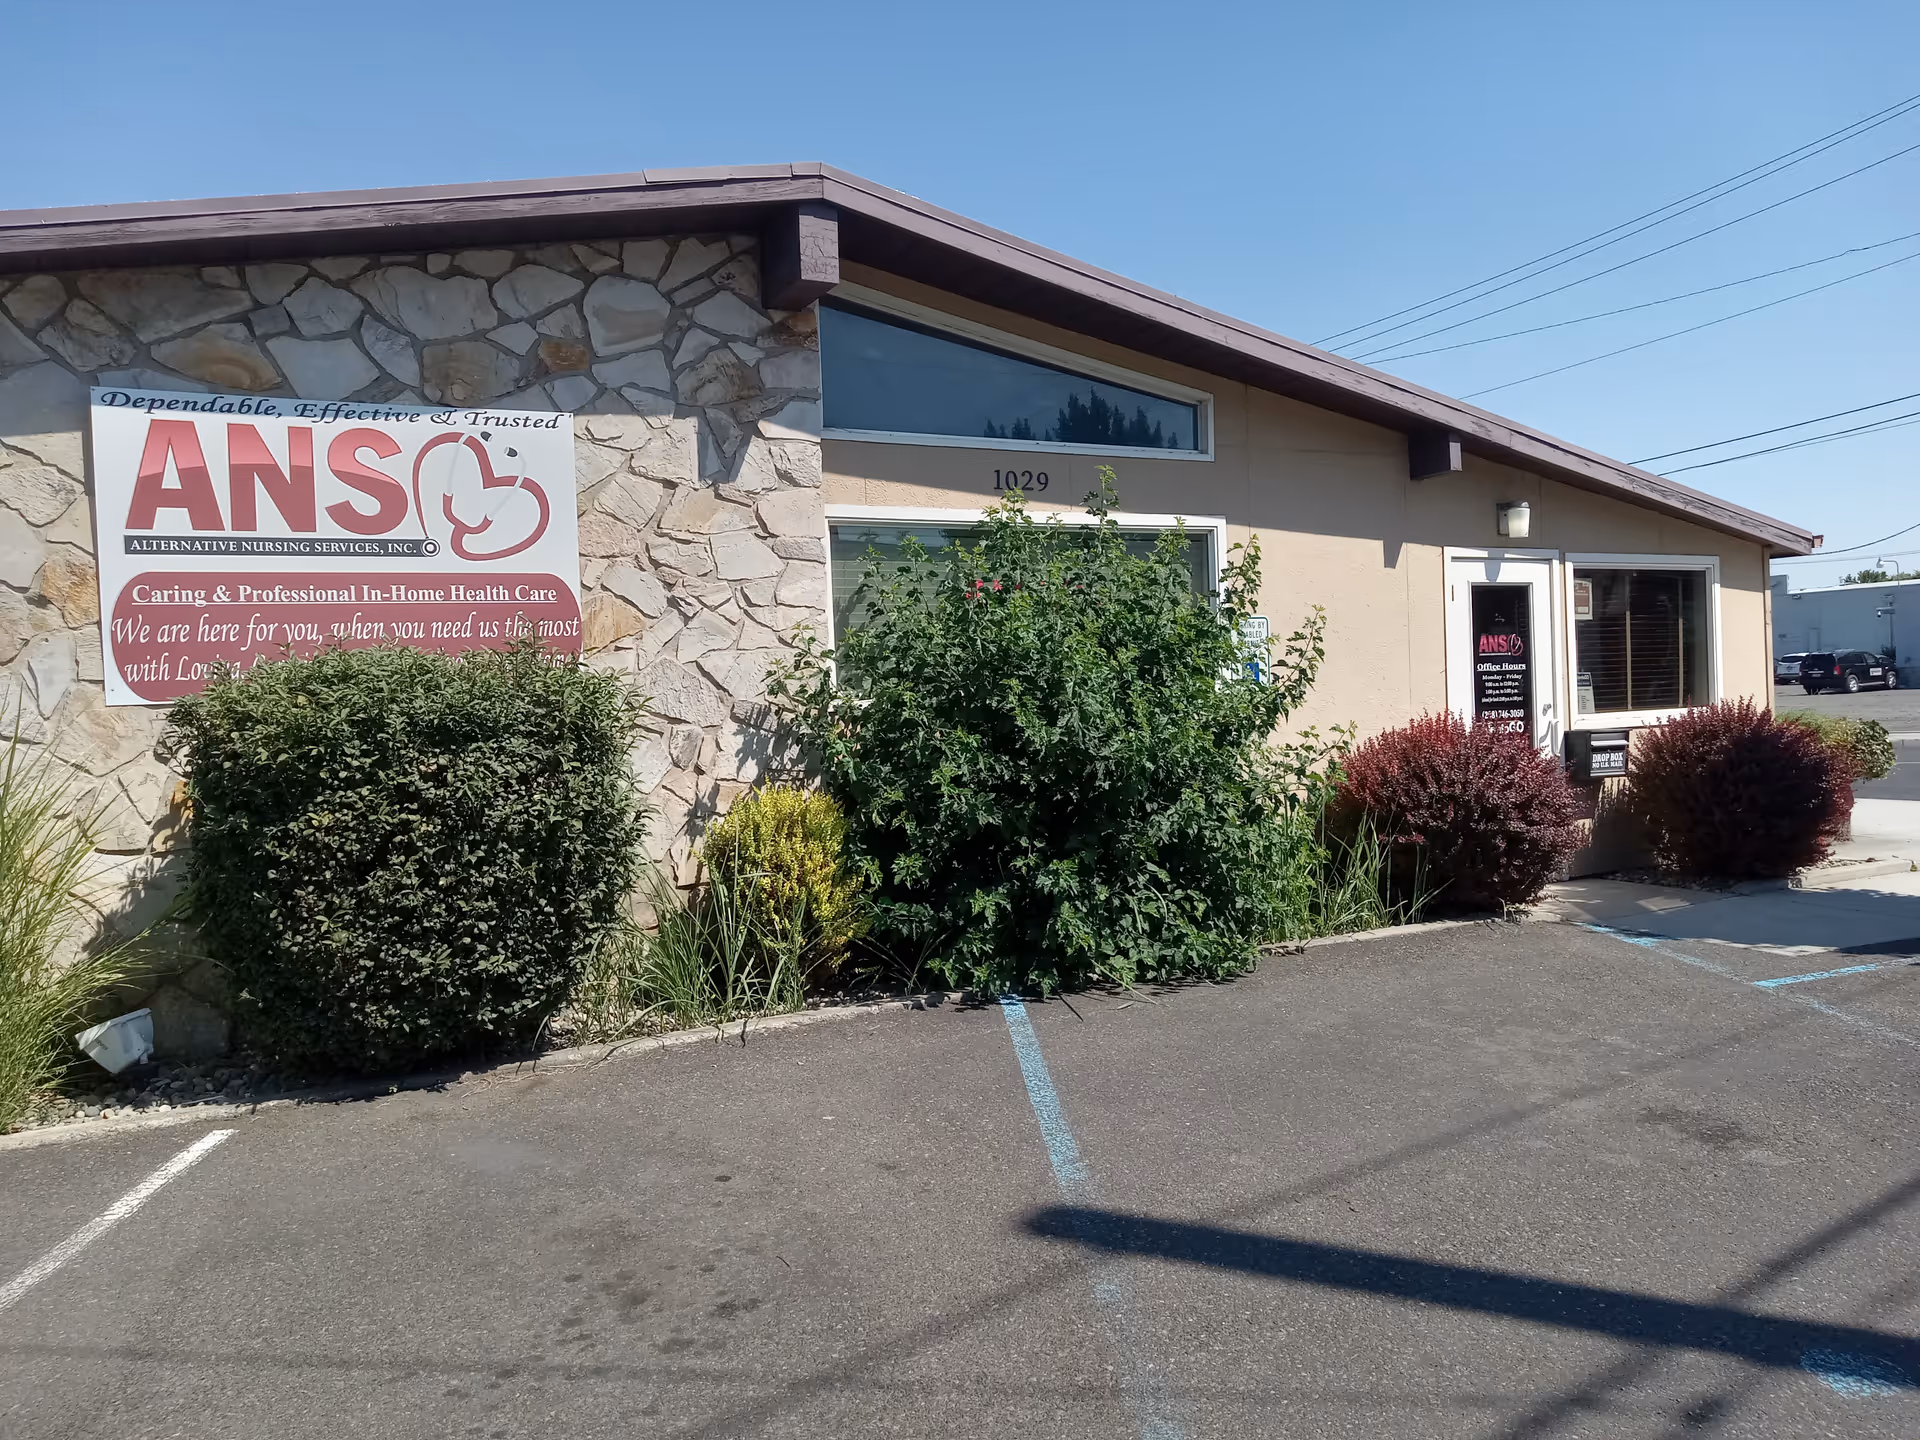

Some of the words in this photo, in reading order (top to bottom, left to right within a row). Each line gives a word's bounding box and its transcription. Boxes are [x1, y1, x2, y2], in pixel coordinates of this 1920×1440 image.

[100, 391, 283, 419] Dependable,
[294, 402, 421, 424] Effective
[430, 410, 457, 426] &
[124, 418, 409, 535] ANS
[993, 469, 1049, 491] 1029
[130, 538, 238, 553] ALTERNATIVE
[241, 541, 310, 553] NURSING
[313, 542, 385, 555] SERVICES,
[387, 543, 417, 554] INC.
[131, 585, 207, 607] Caring
[212, 585, 232, 603] &
[237, 585, 356, 603] Professional
[361, 584, 445, 602] In-Home
[449, 584, 510, 602] Health
[514, 584, 558, 602] Care
[111, 613, 150, 644] We
[157, 623, 191, 643] are
[197, 613, 240, 643] here
[240, 612, 279, 651] for
[281, 622, 324, 650] you,
[331, 612, 385, 641] when
[390, 620, 425, 648] you
[430, 611, 477, 639] need
[479, 621, 499, 637] us
[1479, 634, 1508, 653] ANS
[125, 652, 170, 683] with
[1477, 663, 1501, 672] Office
[1503, 662, 1527, 671] Hours
[1592, 754, 1610, 763] DROP
[1610, 753, 1623, 761] BOX
